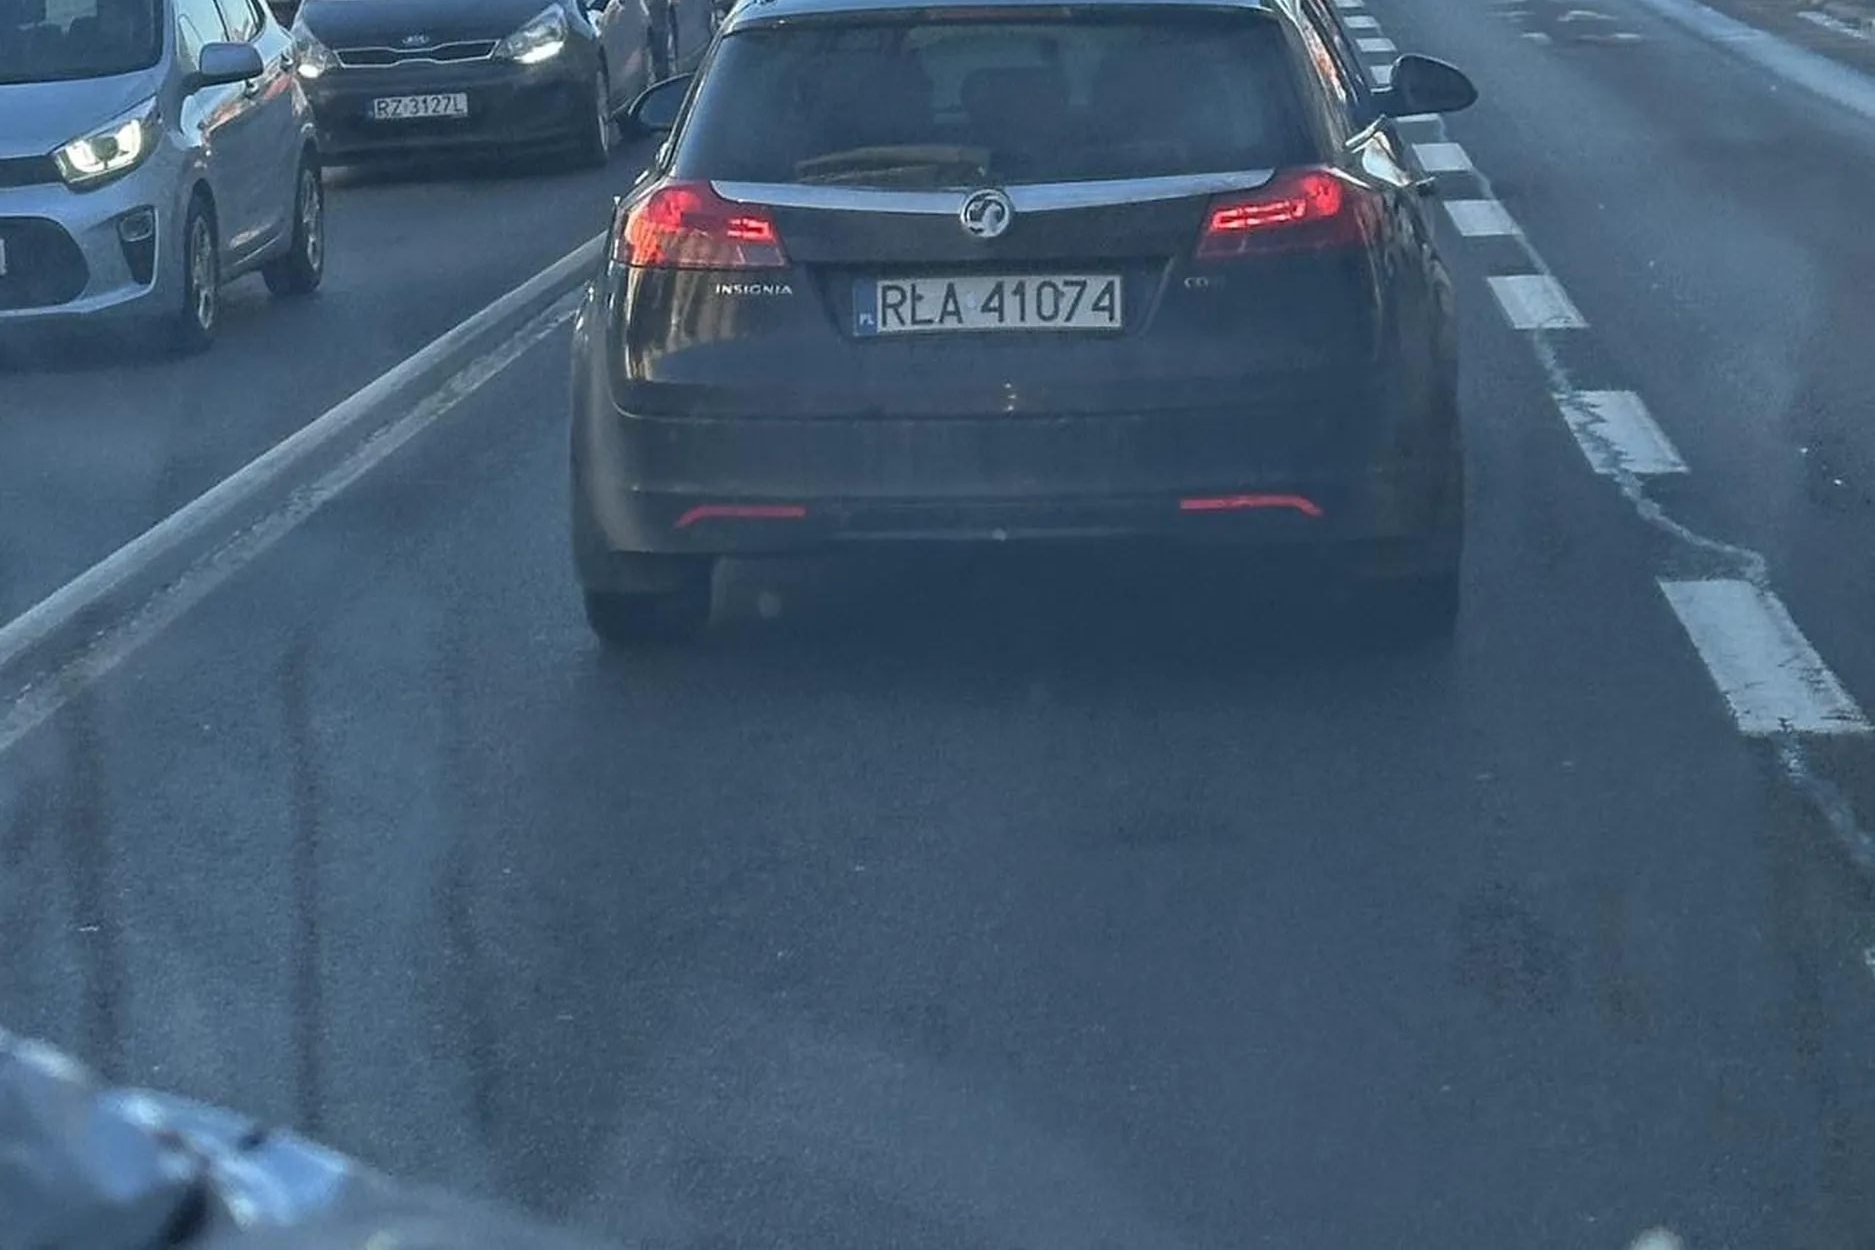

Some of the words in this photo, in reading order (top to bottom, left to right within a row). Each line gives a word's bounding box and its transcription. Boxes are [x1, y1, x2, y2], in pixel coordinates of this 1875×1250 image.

[376, 98, 402, 117] RZ
[715, 283, 793, 295] INSIGNIA
[881, 282, 963, 327] RŁA
[980, 280, 1116, 323] 41074
